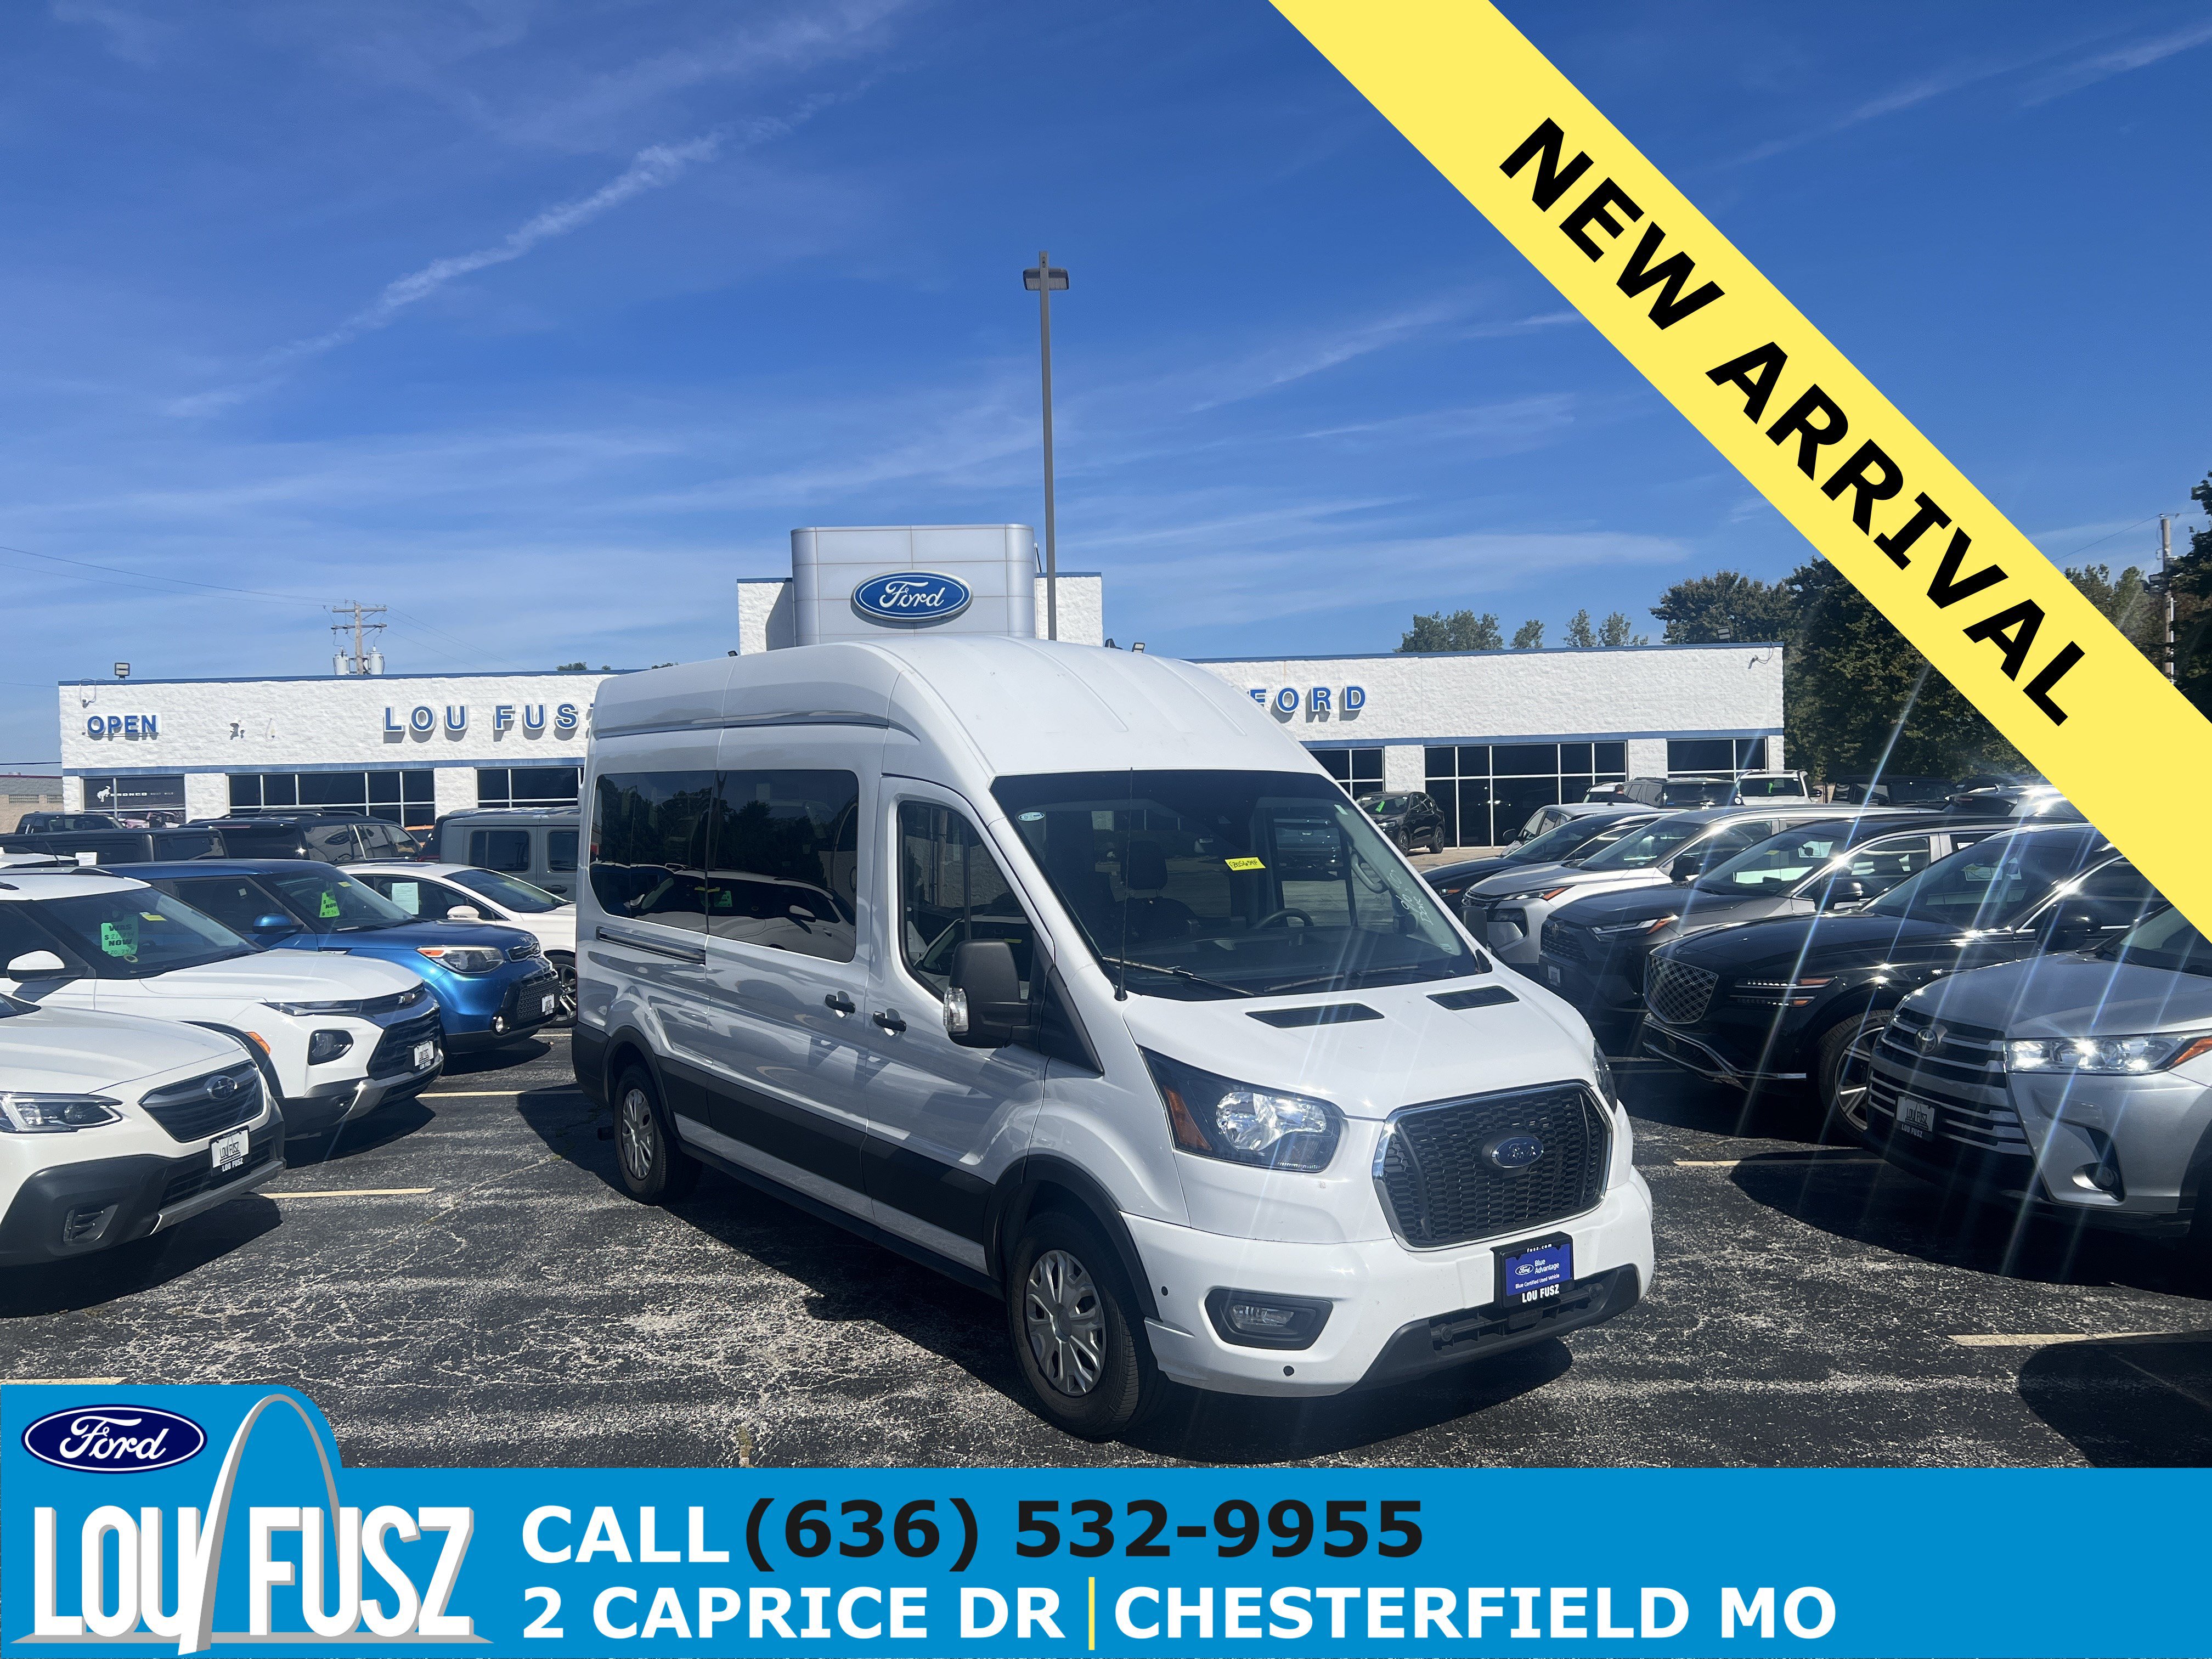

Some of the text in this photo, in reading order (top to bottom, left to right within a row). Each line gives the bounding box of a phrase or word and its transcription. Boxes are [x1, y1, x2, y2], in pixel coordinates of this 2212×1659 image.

[879, 580, 946, 608] Ford
[87, 715, 157, 734] OPEN
[385, 705, 466, 731] LOU
[495, 703, 594, 730] FUS
[1527, 1243, 1552, 1253] fusz.com
[1534, 1259, 1545, 1267] Blue
[1534, 1262, 1560, 1274] Advantage
[1522, 1283, 1560, 1304] LOU FUSZ
